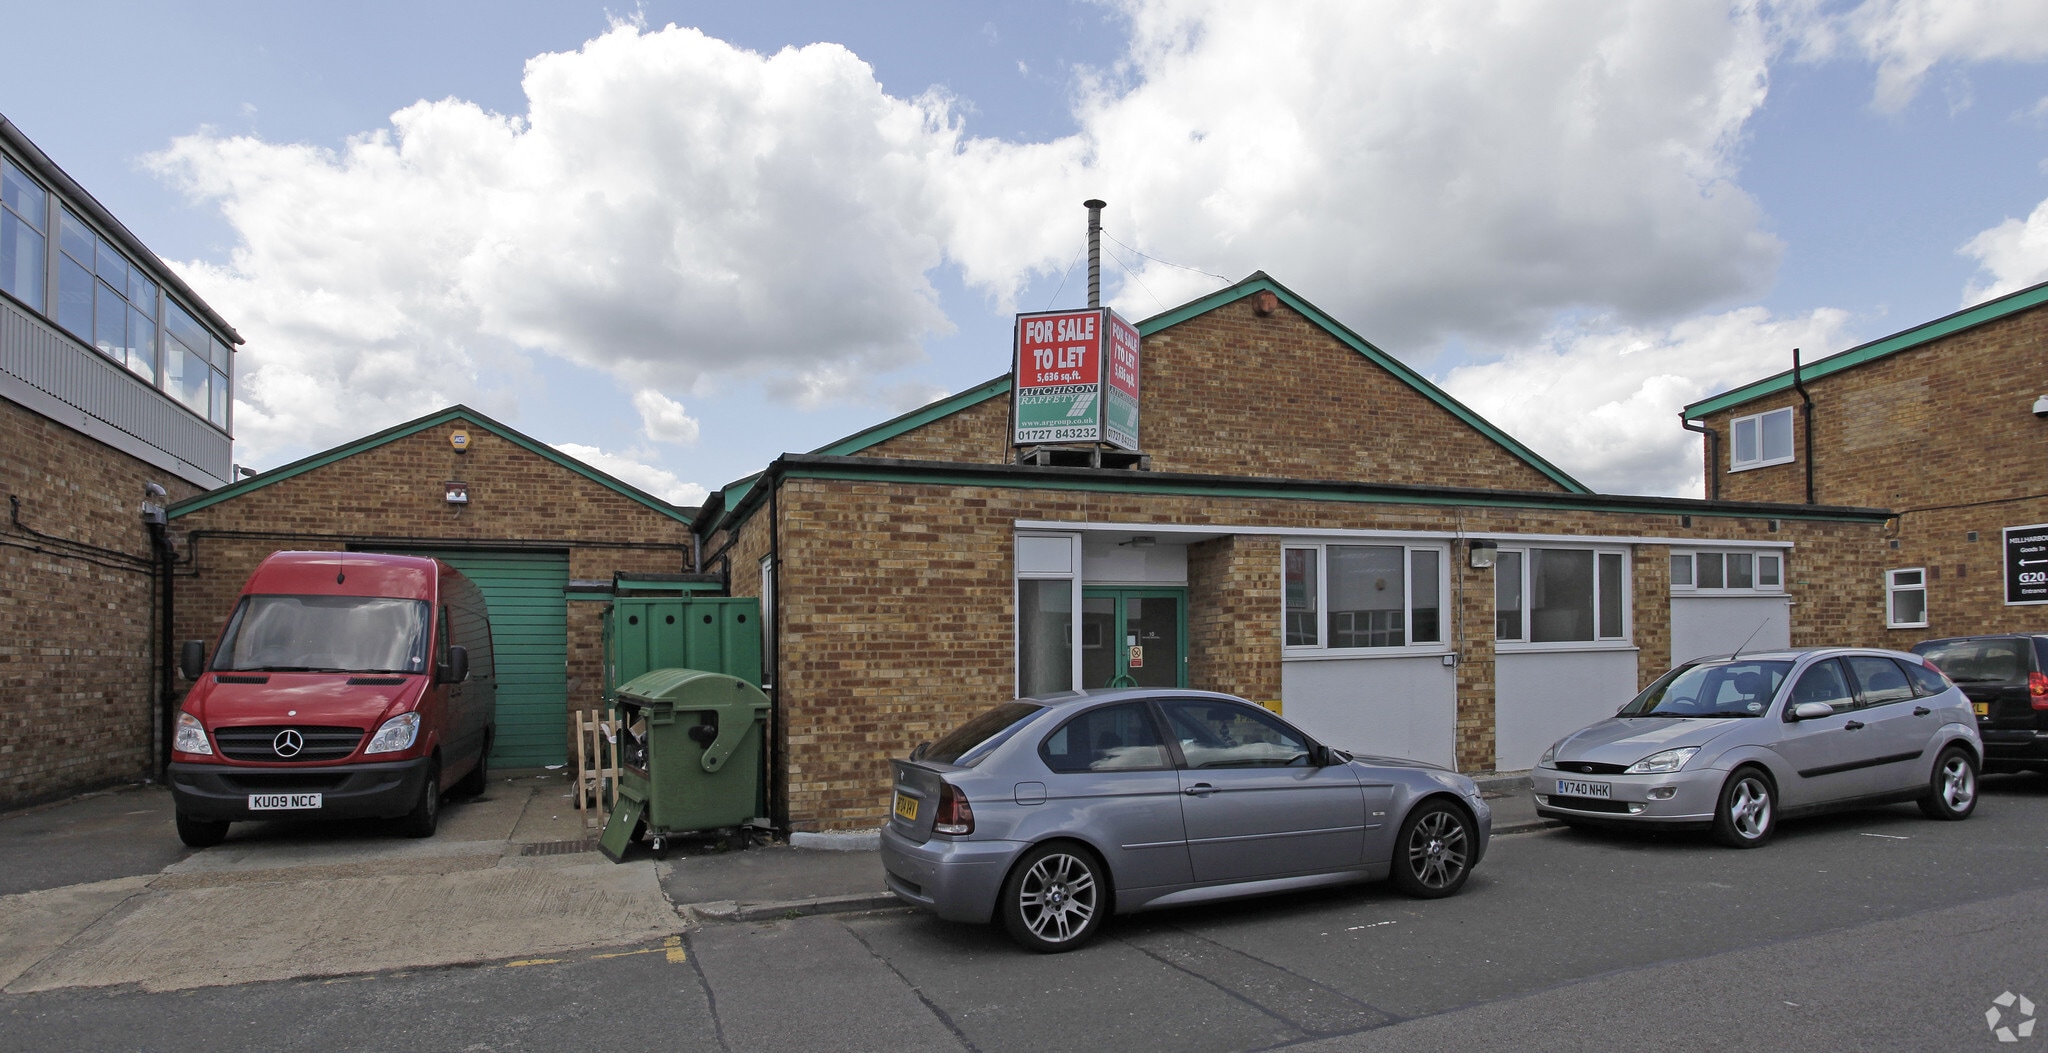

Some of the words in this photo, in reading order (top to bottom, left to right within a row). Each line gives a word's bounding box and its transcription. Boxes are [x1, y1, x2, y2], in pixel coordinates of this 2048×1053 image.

[1025, 320, 1054, 345] FOR
[1057, 317, 1095, 342] SALE
[1112, 321, 1125, 344] FOR
[1125, 331, 1138, 354] SALE
[1033, 348, 1054, 370] TO
[1058, 346, 1086, 369] LET
[1126, 350, 1136, 370] LET
[1036, 372, 1059, 383] 5,636
[1060, 370, 1082, 383] sq.ft.
[1021, 384, 1097, 396] AITCHISON
[1020, 394, 1078, 405] RAFFETY
[1021, 417, 1094, 427] www.argroup.co.uk
[1018, 430, 1052, 440] 01727
[1055, 428, 1097, 439] 843232
[1564, 782, 1587, 795] V740
[1590, 784, 1609, 797] NHK
[254, 796, 288, 807] KU09
[291, 795, 317, 807] NCC
